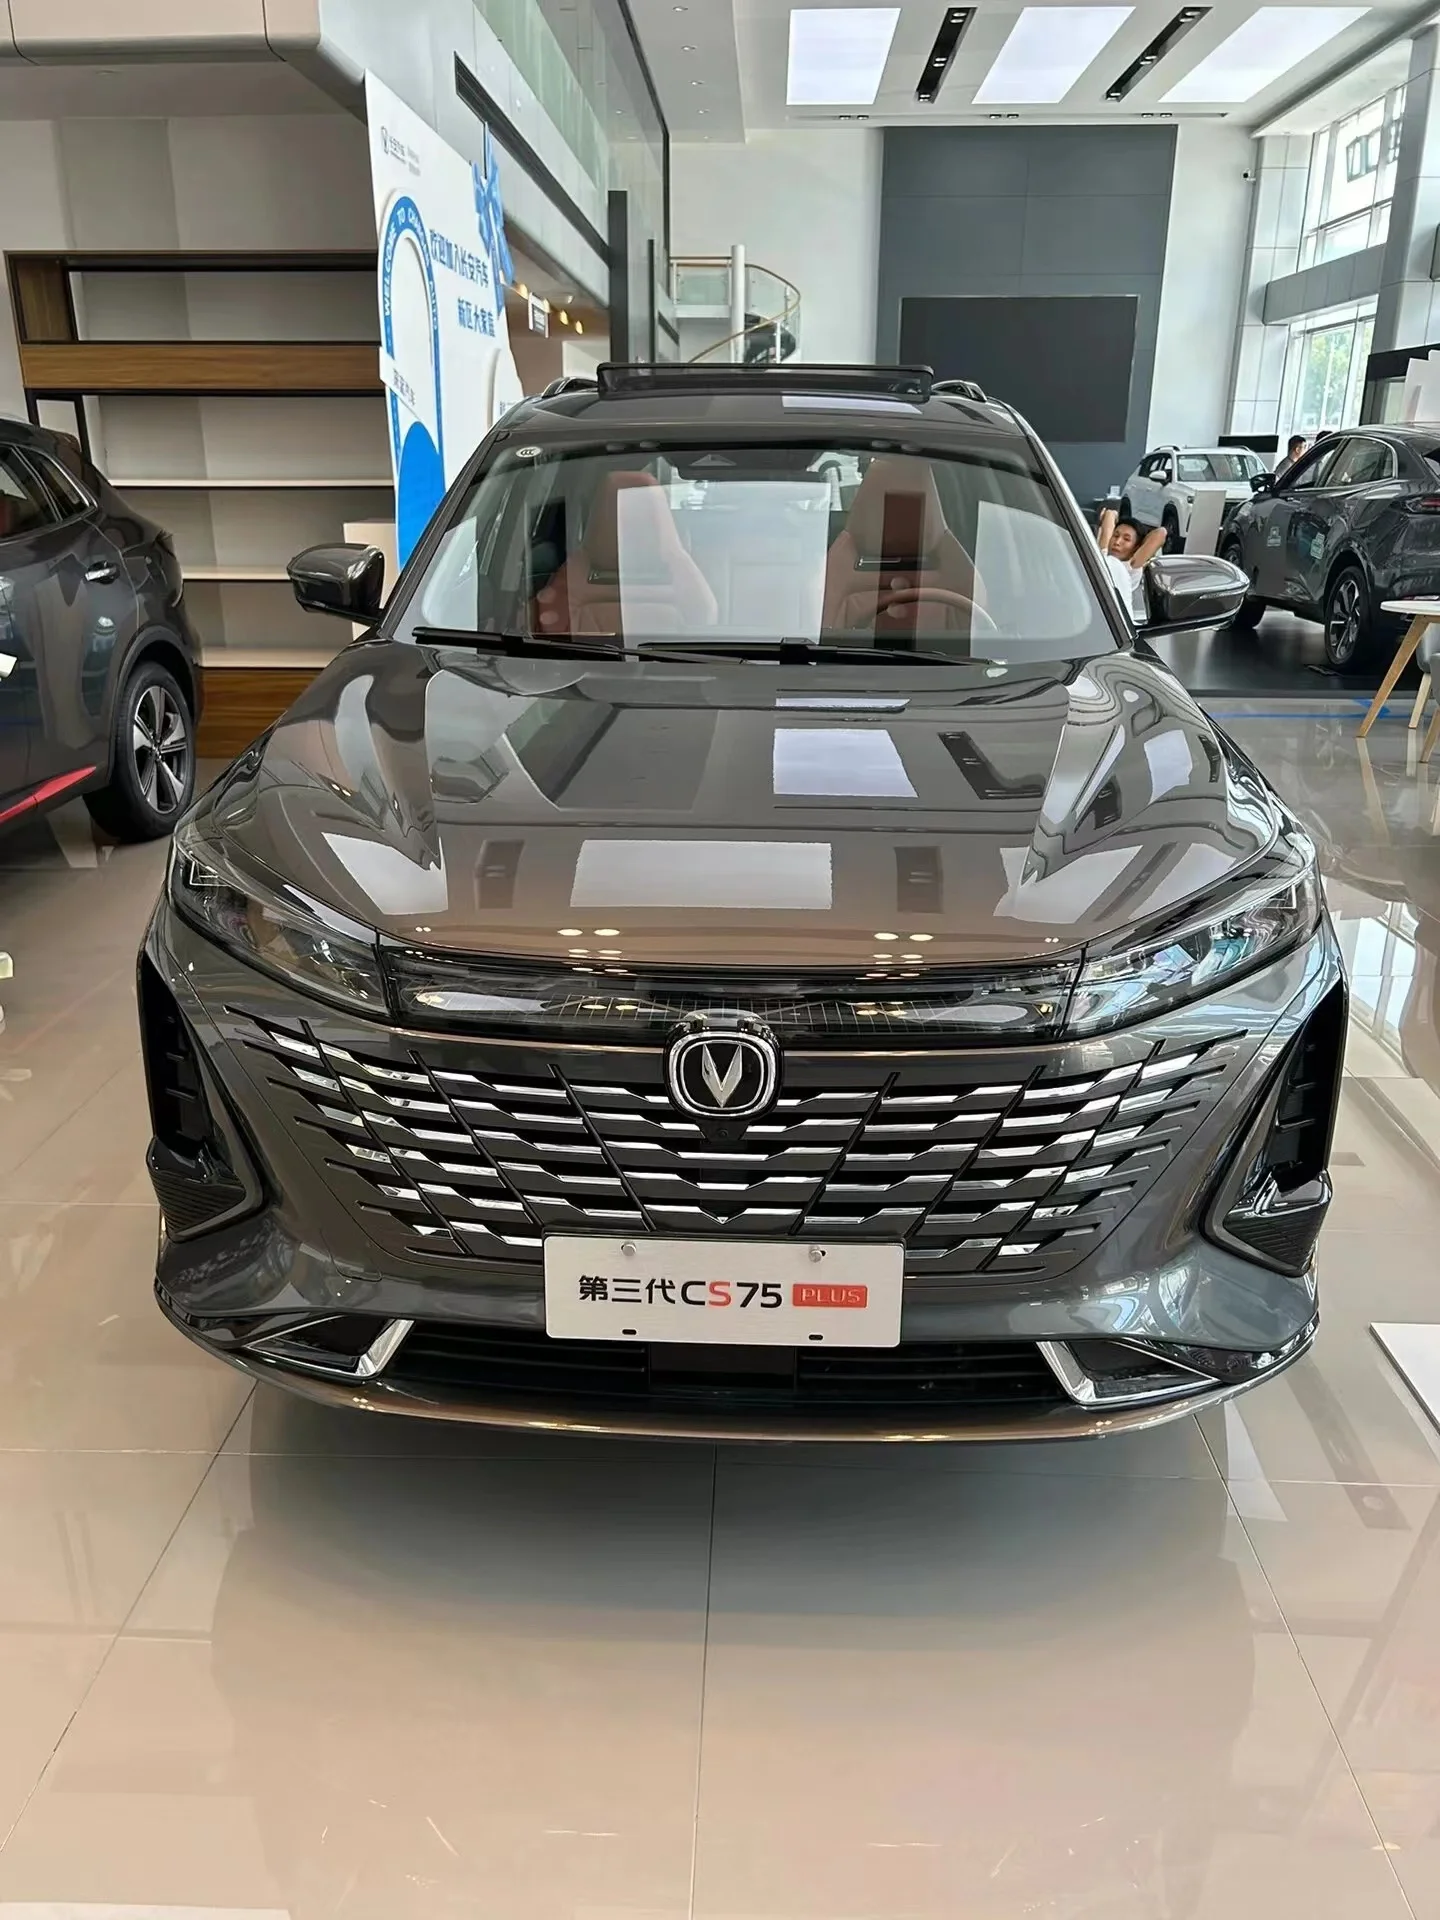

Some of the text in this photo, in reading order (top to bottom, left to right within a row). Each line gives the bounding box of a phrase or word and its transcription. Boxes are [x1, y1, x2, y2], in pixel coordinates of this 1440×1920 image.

[430, 229, 489, 288] 欢迎加入长安汽车
[578, 1275, 863, 1309] 第三代CS75 PLUS
